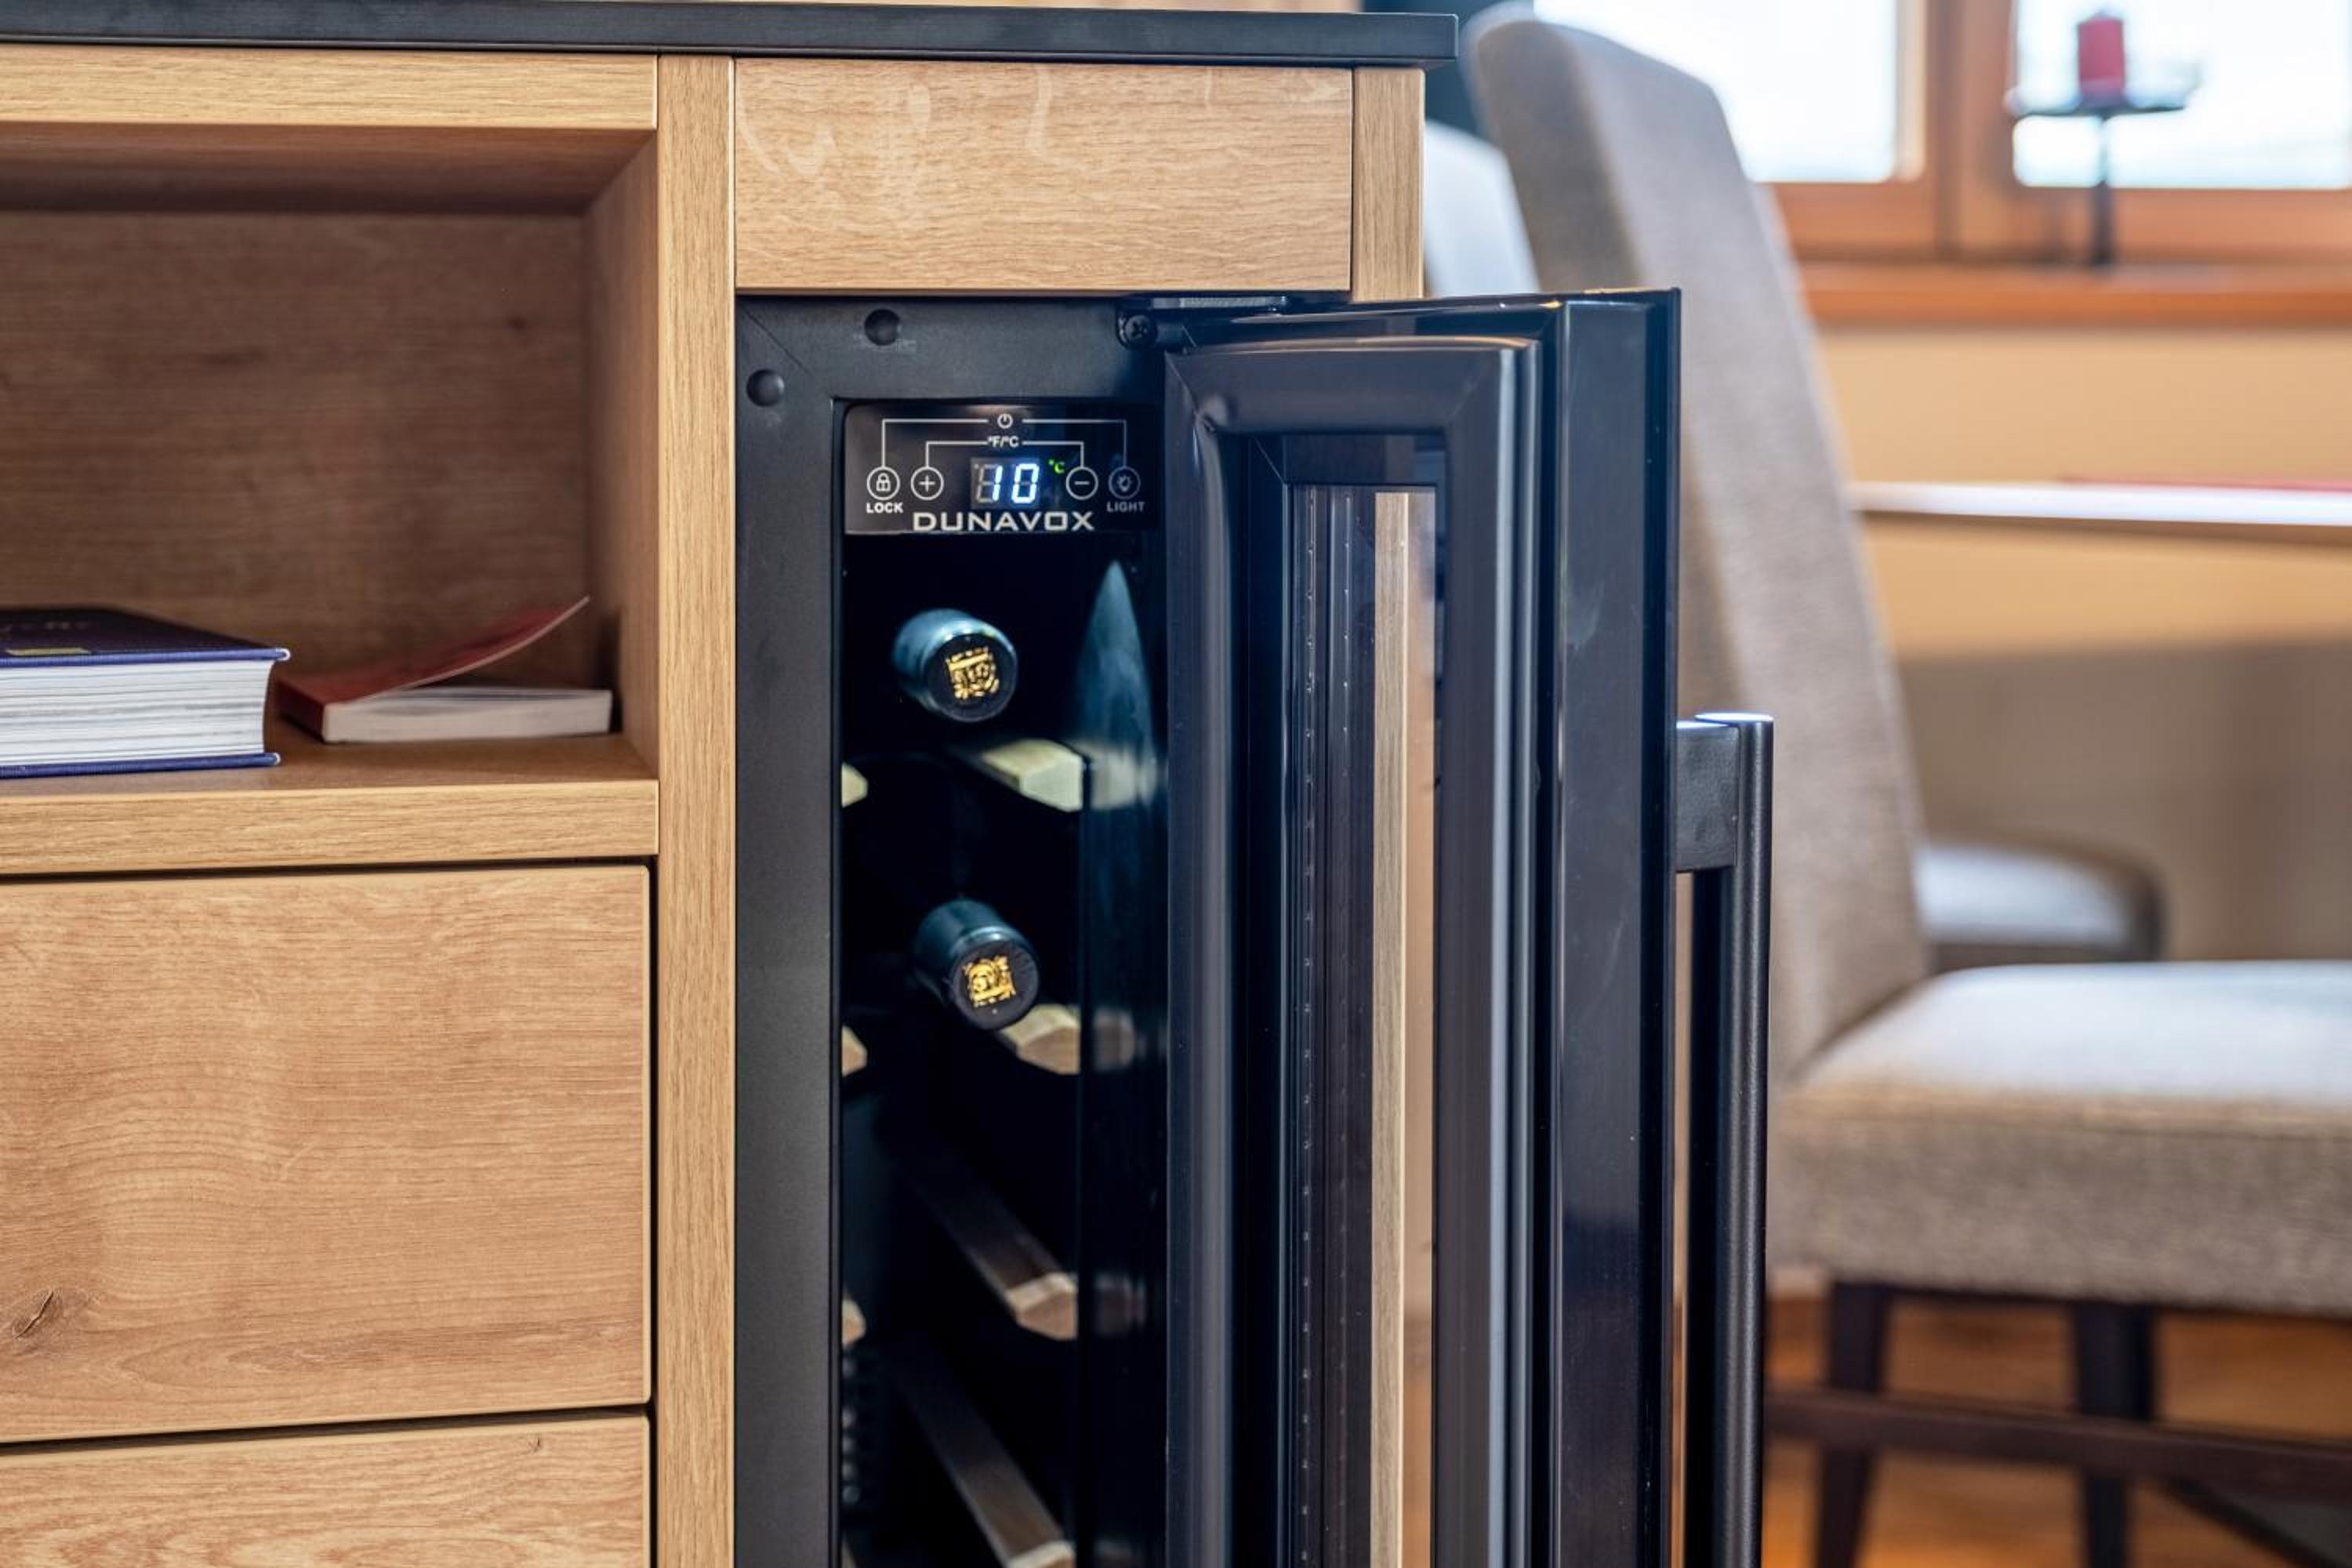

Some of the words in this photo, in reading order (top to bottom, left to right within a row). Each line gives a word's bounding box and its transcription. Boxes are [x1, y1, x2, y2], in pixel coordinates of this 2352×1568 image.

[992, 464, 1041, 503] 10
[1048, 459, 1065, 474] °C
[866, 502, 903, 514] LOCK
[1106, 502, 1145, 512] LIGHT
[913, 511, 1095, 532] DUNAVOX
